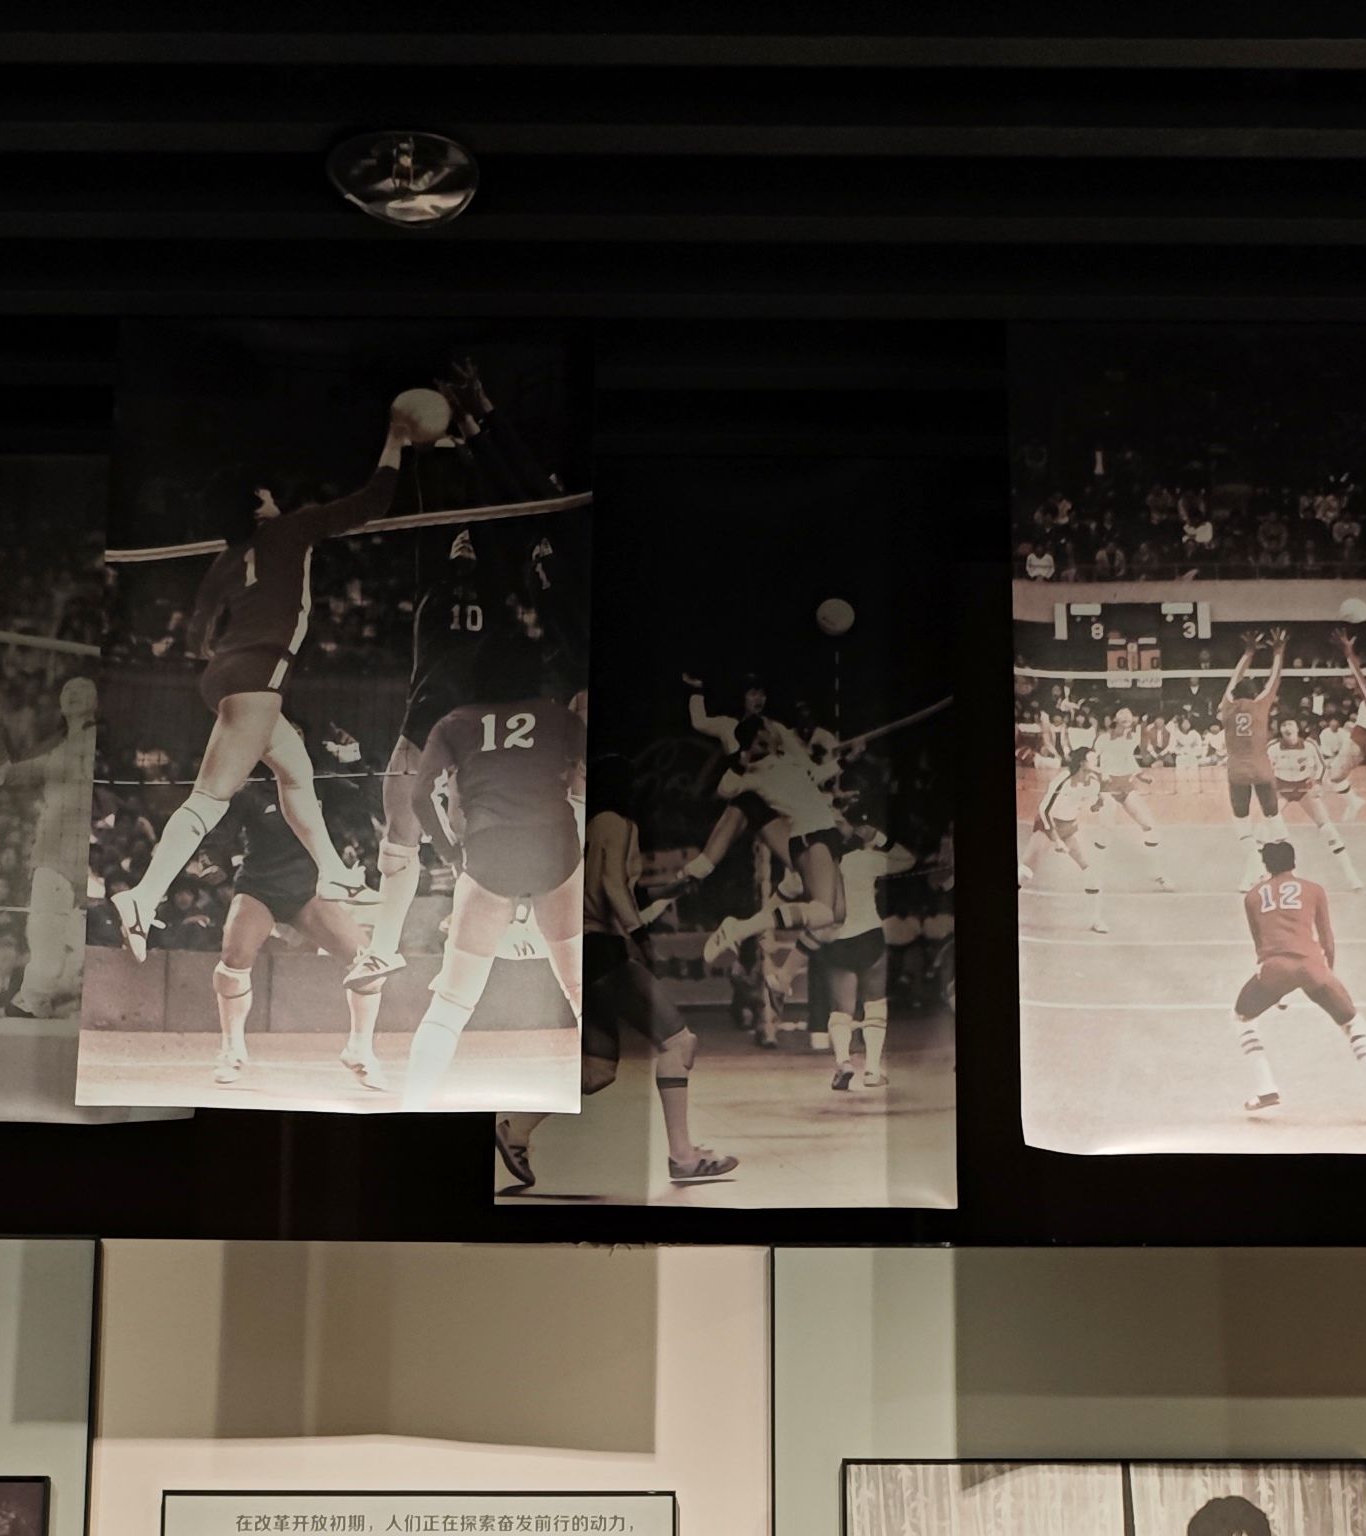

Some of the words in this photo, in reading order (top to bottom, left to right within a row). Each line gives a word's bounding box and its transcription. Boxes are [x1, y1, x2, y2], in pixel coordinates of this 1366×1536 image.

[449, 604, 484, 632] 10
[480, 712, 537, 752] 12
[1235, 712, 1253, 737] 2
[1258, 880, 1303, 913] 12
[236, 1514, 633, 1532] 在改革开放初期，人们正在探索奋发前行的动力，
